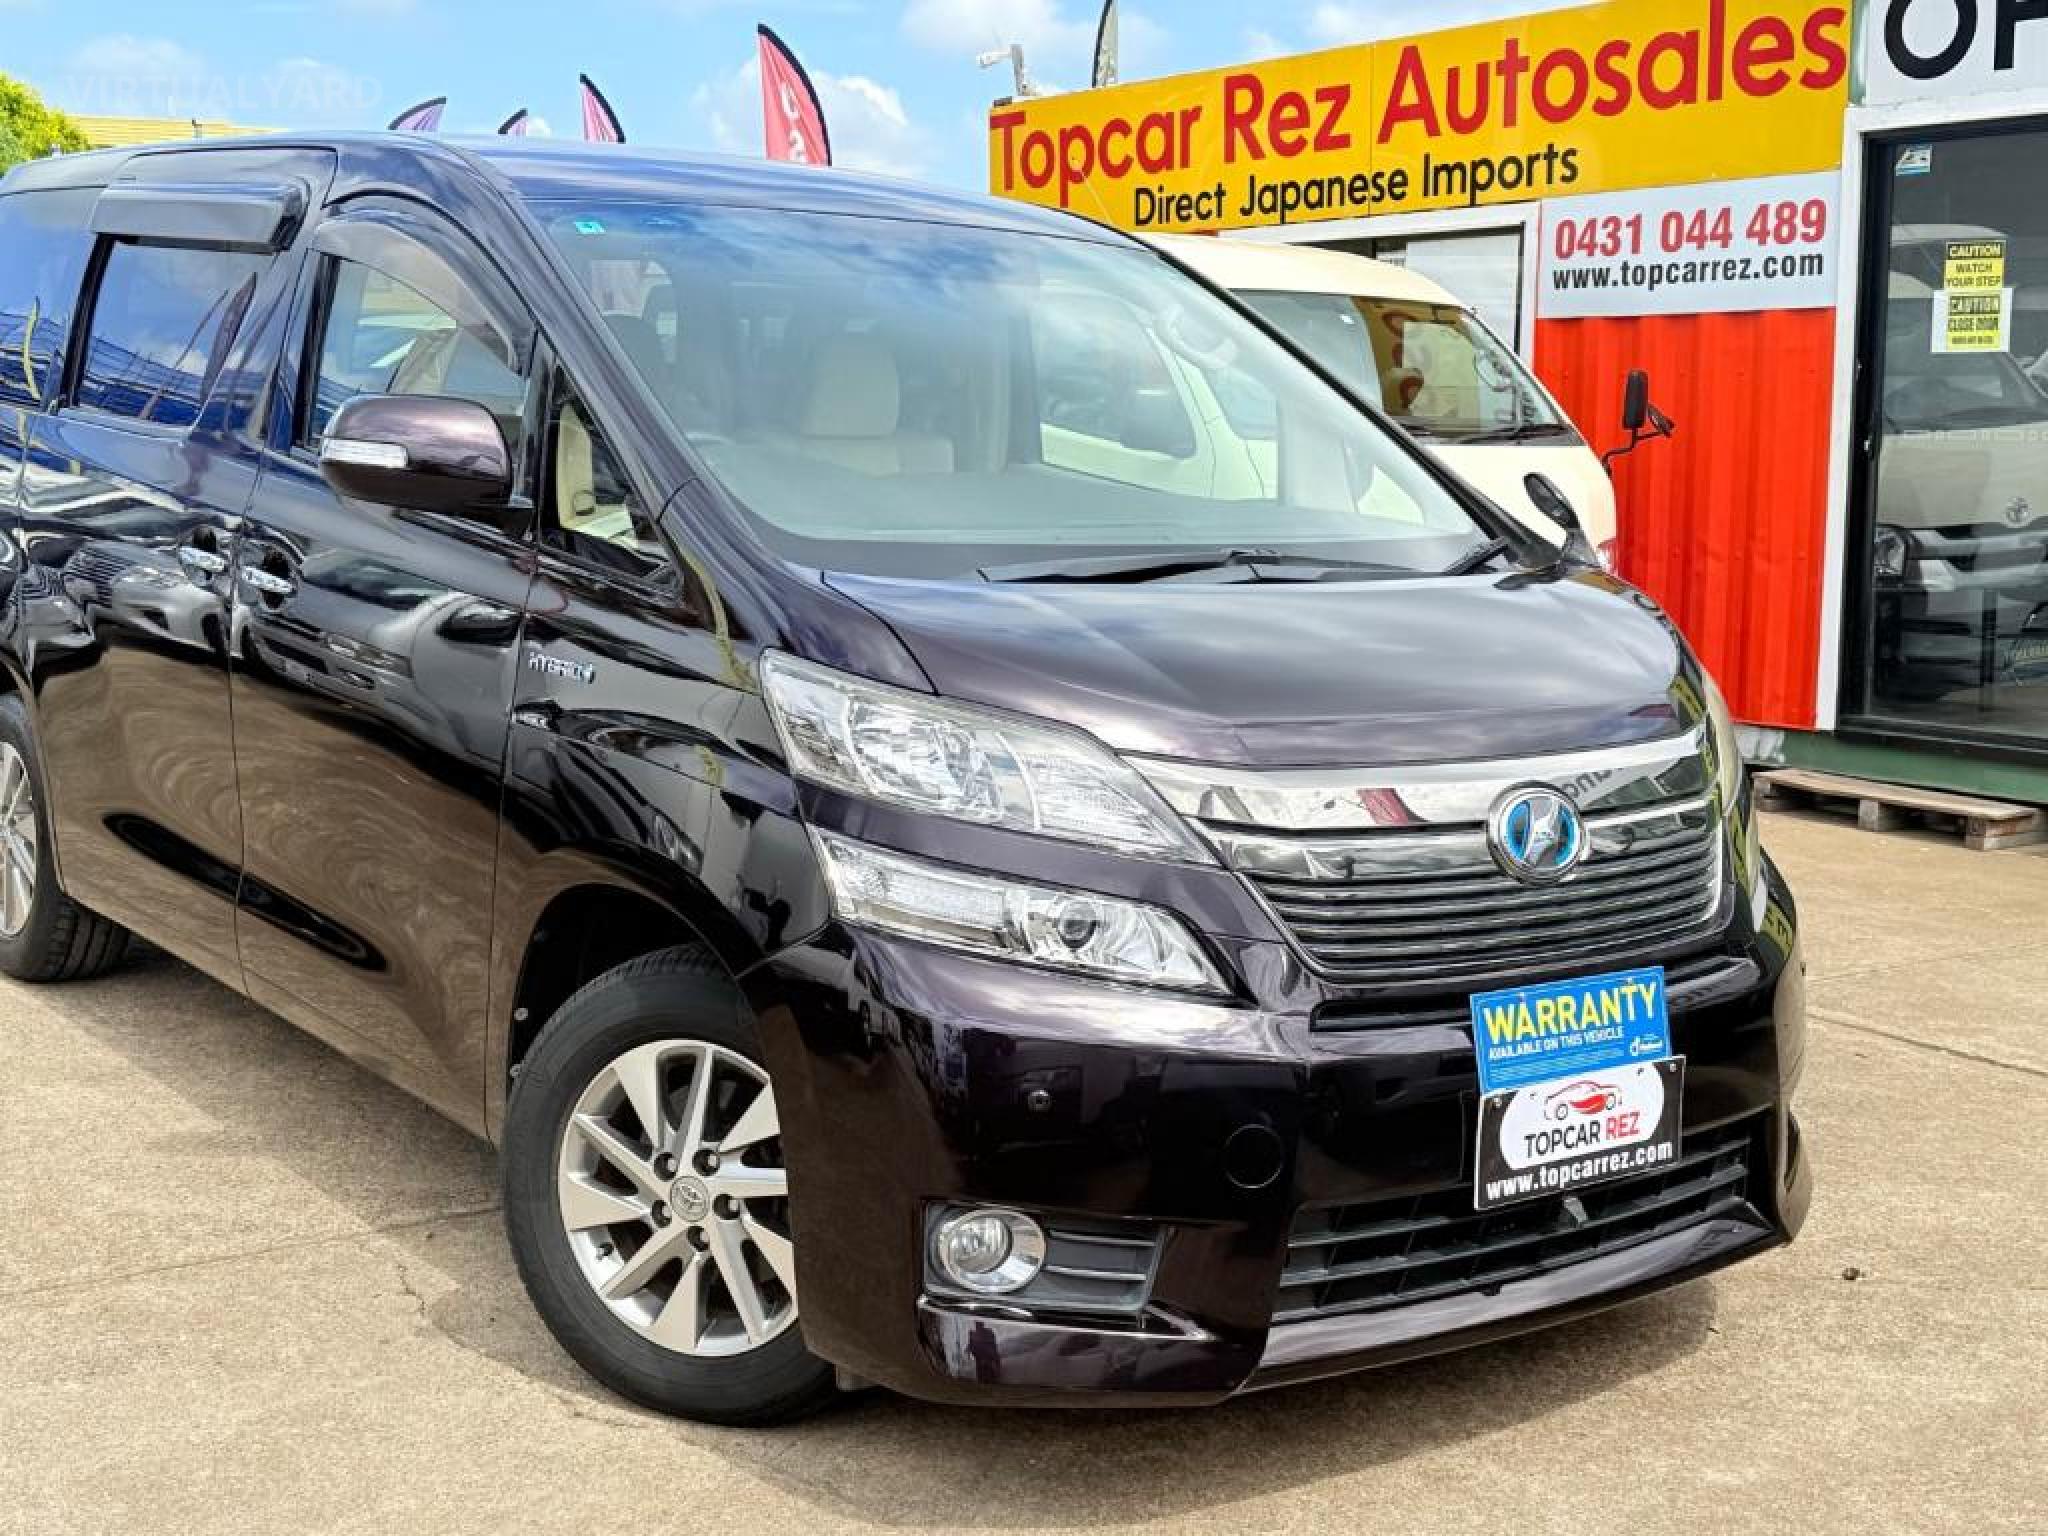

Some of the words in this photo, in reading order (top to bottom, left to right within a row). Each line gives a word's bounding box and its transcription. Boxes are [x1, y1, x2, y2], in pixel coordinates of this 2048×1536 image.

[990, 104, 1203, 208] Topcar
[1223, 74, 1351, 163] Rez
[1377, 0, 1847, 144] Autosales
[1134, 187, 1226, 226] Direct
[1239, 170, 1409, 225] Japanese
[1423, 144, 1579, 206] Imports
[1554, 214, 1644, 261] 0431
[1659, 206, 1734, 253] 044
[1745, 199, 1828, 246] 489
[1949, 244, 2001, 257] CAUTION
[1552, 249, 1825, 293] www.topcarrez.com
[1946, 277, 1975, 288] YOUR
[1976, 275, 2001, 287] STEP
[1955, 263, 1993, 274] WATCH
[1484, 982, 1657, 1045] WARRANTY
[1489, 1038, 1543, 1060] AVAILABLE
[1544, 1036, 1559, 1051] ON
[1561, 1033, 1583, 1048] THIS
[1585, 1025, 1624, 1044] VEHICLE
[1524, 1119, 1600, 1159] TOPCAR
[1605, 1111, 1640, 1141] REZ
[1486, 1141, 1673, 1201] www.topcarrez.com
